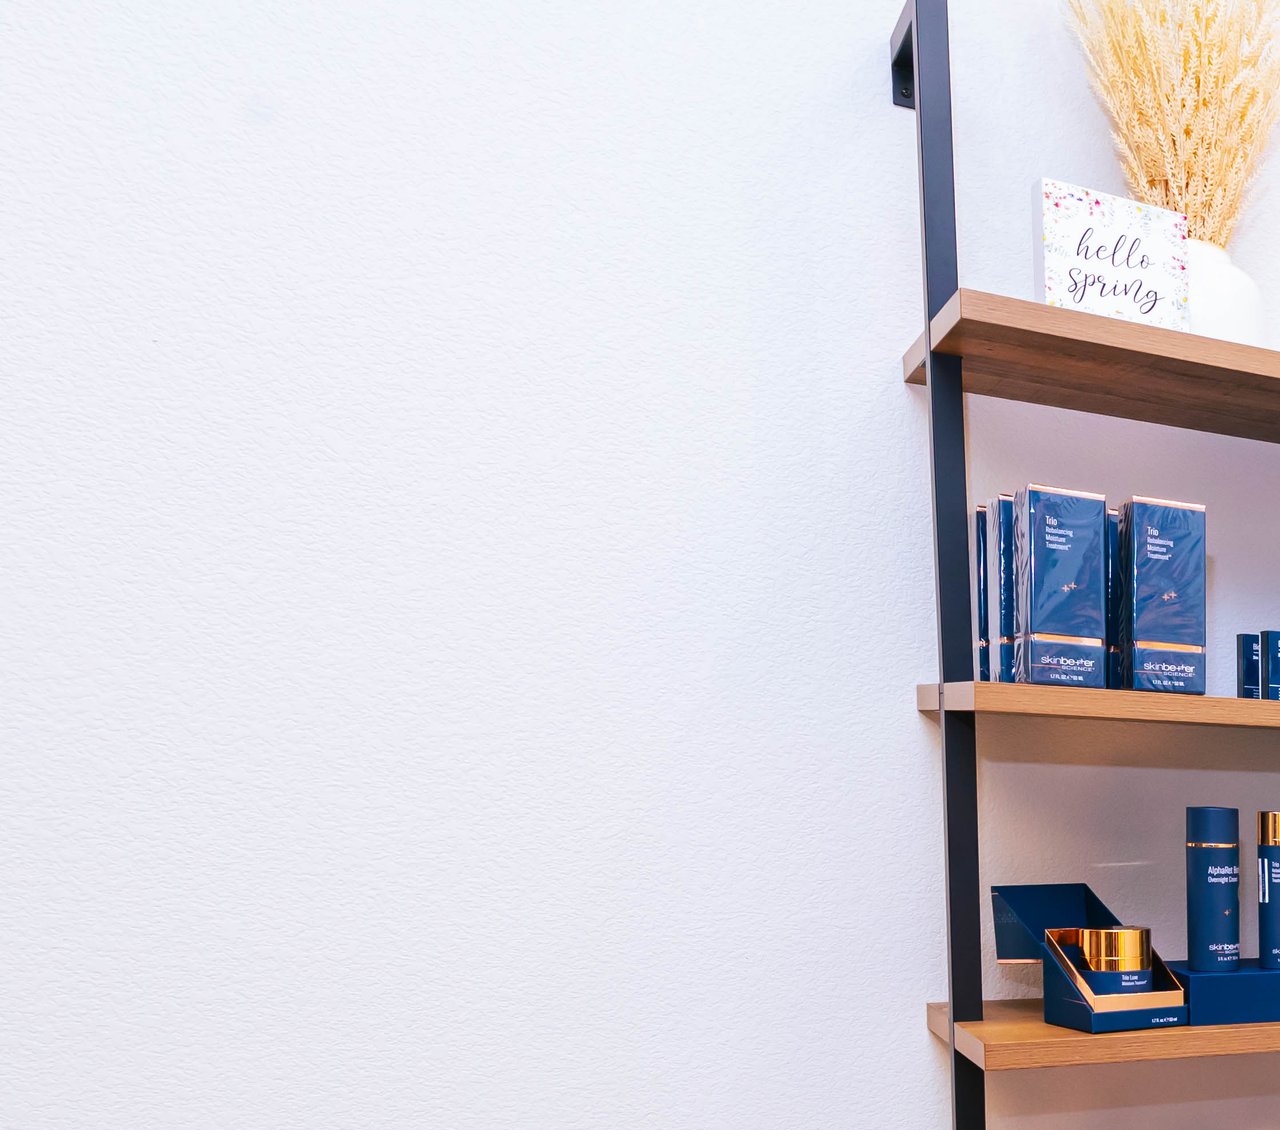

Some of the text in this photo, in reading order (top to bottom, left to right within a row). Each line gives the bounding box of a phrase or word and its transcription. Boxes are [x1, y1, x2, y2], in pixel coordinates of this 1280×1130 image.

[1077, 228, 1155, 269] hello
[1068, 268, 1165, 314] spring
[1046, 516, 1058, 526] Trio
[1147, 527, 1159, 536] Trio
[1041, 656, 1095, 667] skinbetter
[1144, 662, 1195, 673] skinbetter
[1208, 866, 1232, 876] AlphaRet
[1208, 876, 1228, 884] Overnight
